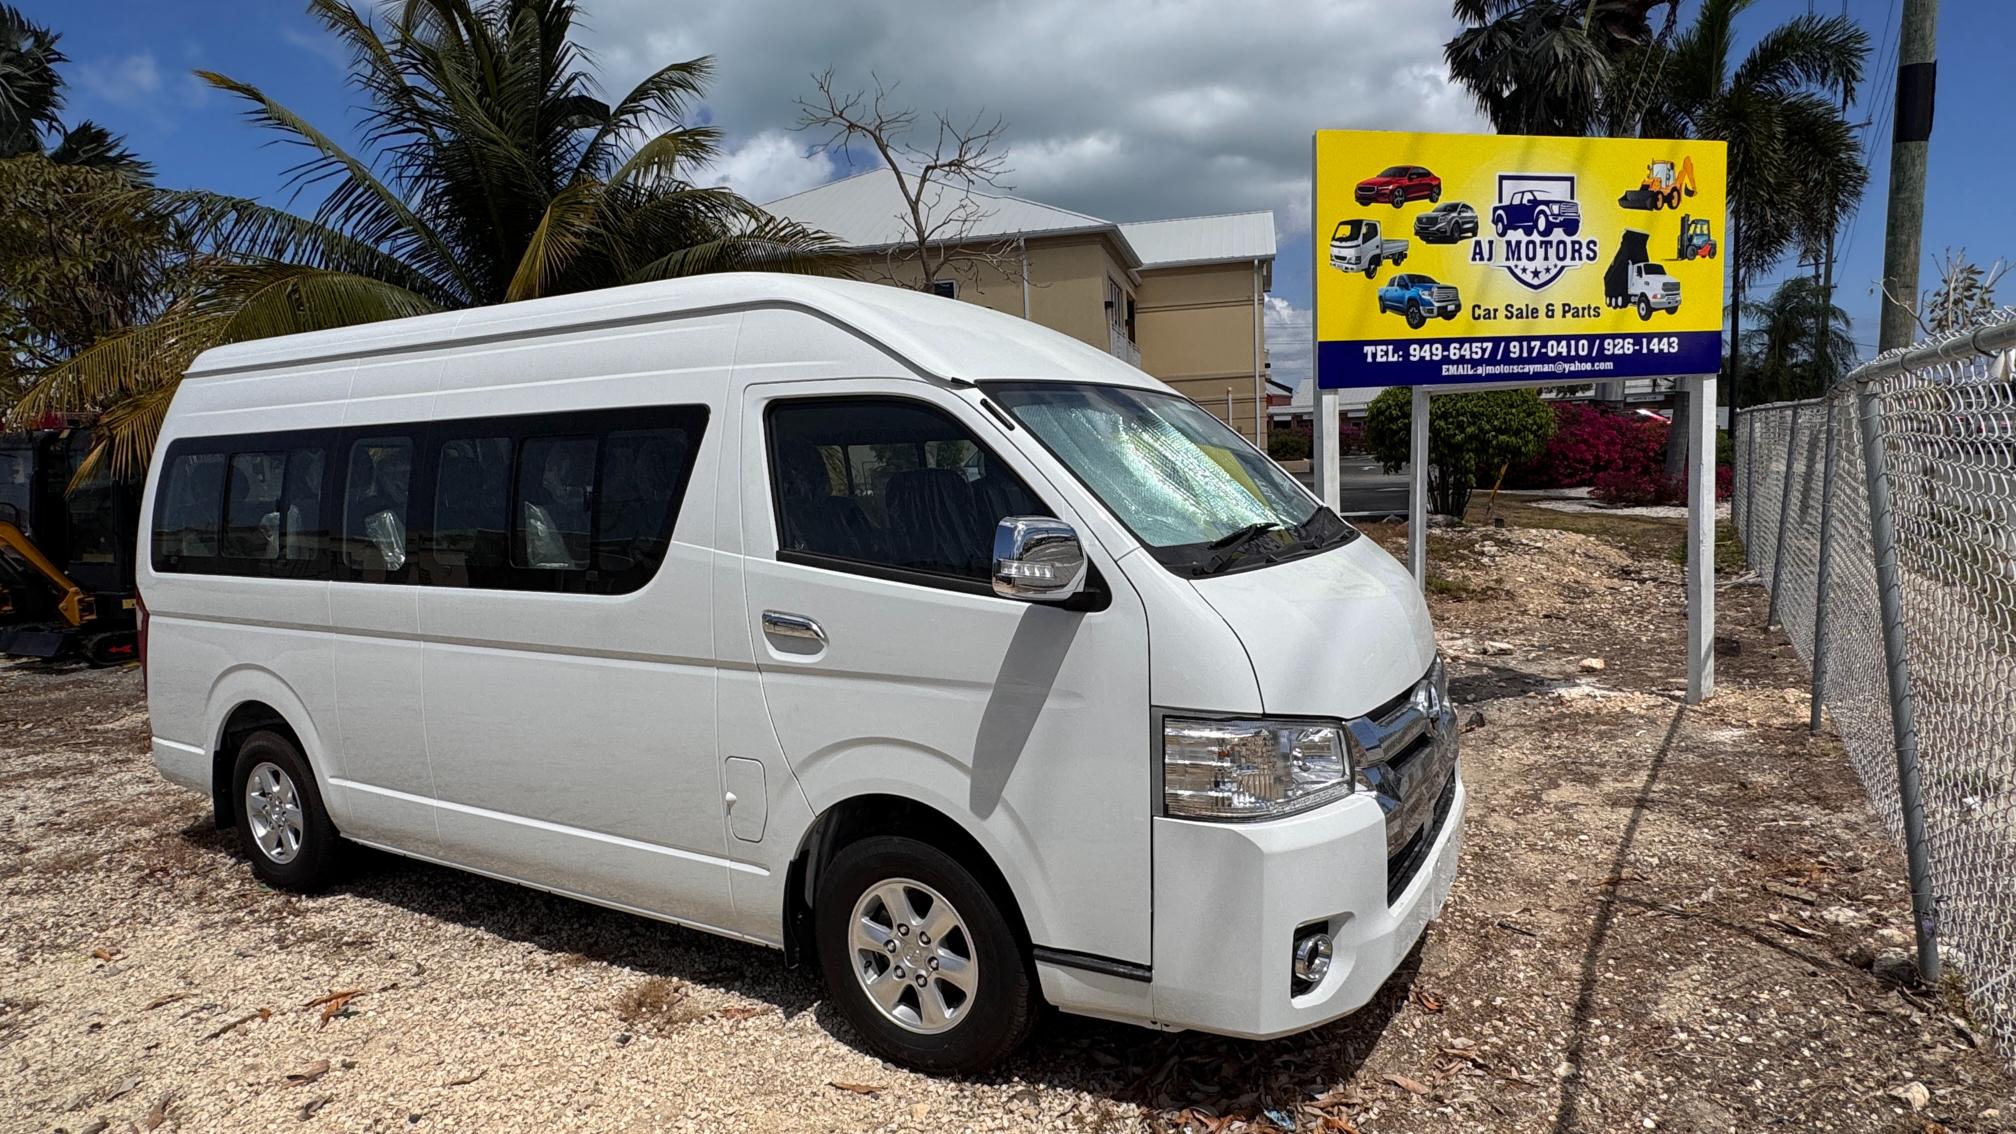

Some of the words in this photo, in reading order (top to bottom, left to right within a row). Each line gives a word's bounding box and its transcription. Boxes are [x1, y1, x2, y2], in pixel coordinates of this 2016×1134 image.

[1471, 239, 1495, 262] AJ
[1504, 239, 1598, 262] MOTORS
[1471, 304, 1499, 321] Car
[1504, 303, 1539, 320] Sale
[1545, 303, 1556, 319] &
[1561, 303, 1601, 319] Parts
[1363, 345, 1403, 363] TEL:
[1409, 342, 1494, 361] 949-6457
[1496, 341, 1506, 360] /
[1509, 339, 1589, 358] 917-0410
[1591, 338, 1601, 357] /
[1603, 336, 1680, 355] 926-1443
[1441, 361, 1614, 376] EMAIL:ajmotorscayman@yahoo.com
